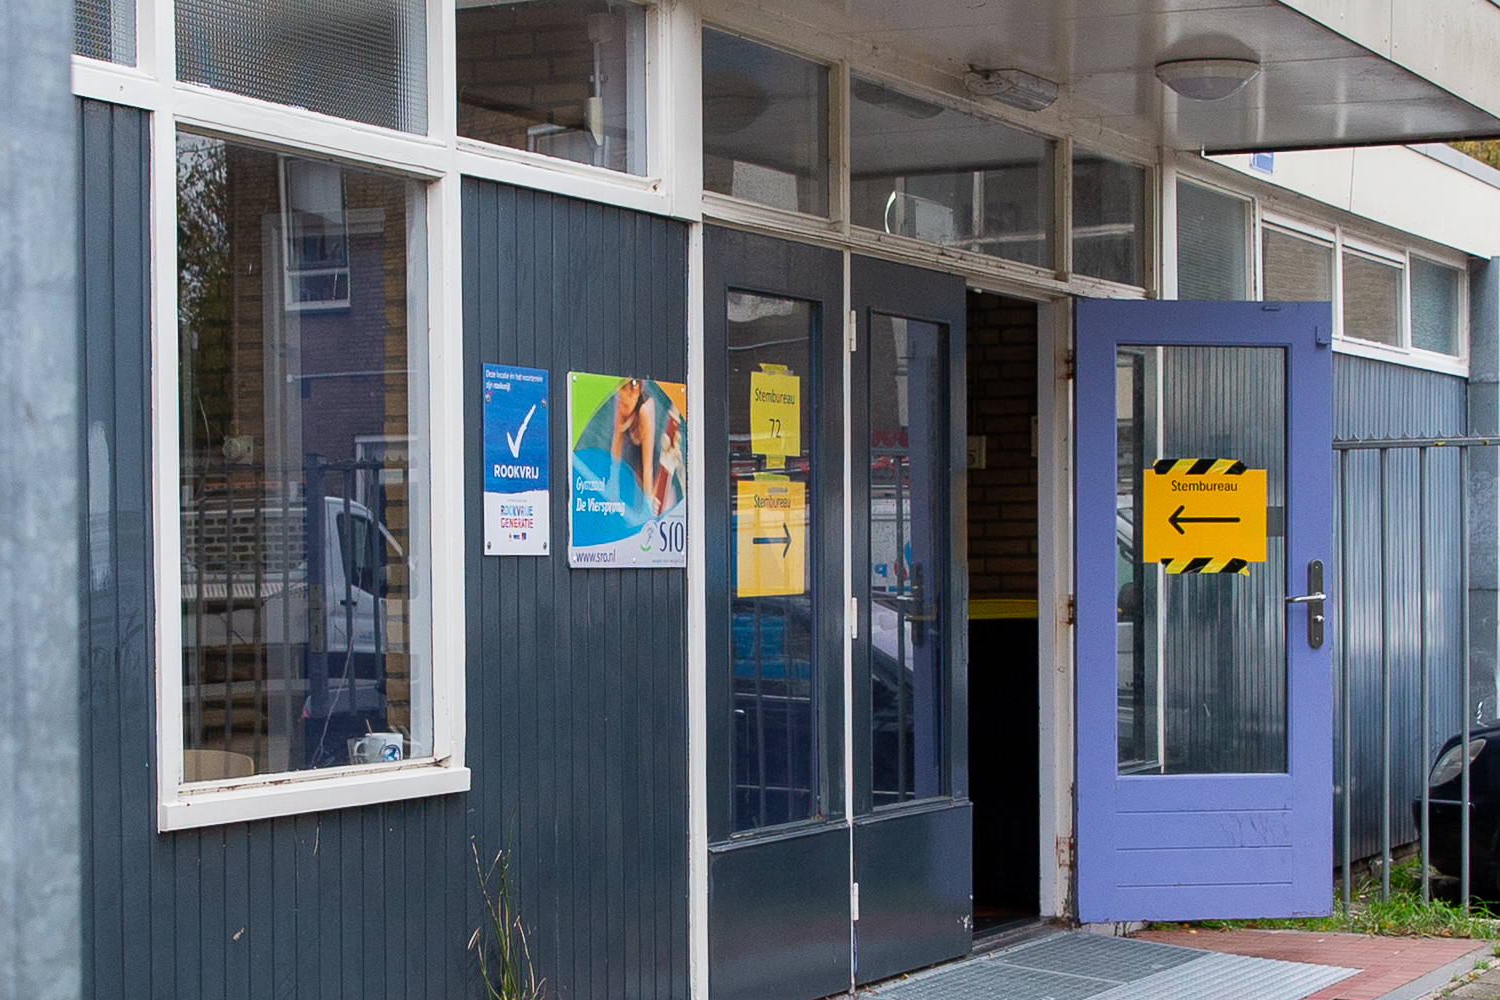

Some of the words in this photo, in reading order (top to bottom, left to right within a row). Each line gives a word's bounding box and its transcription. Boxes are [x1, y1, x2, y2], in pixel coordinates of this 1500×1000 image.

[754, 388, 796, 405] Stembureau
[769, 418, 781, 438] 72
[493, 464, 540, 479] ROOKVRIJ
[576, 476, 605, 494] Gymzaal
[1171, 480, 1238, 491] Stembureau
[576, 497, 587, 512] De
[587, 497, 625, 516] Viersprong
[753, 494, 791, 508] Stembureau
[501, 518, 534, 528] GENERATIE
[659, 521, 684, 552] sro
[576, 549, 616, 563] www.sro.nl
